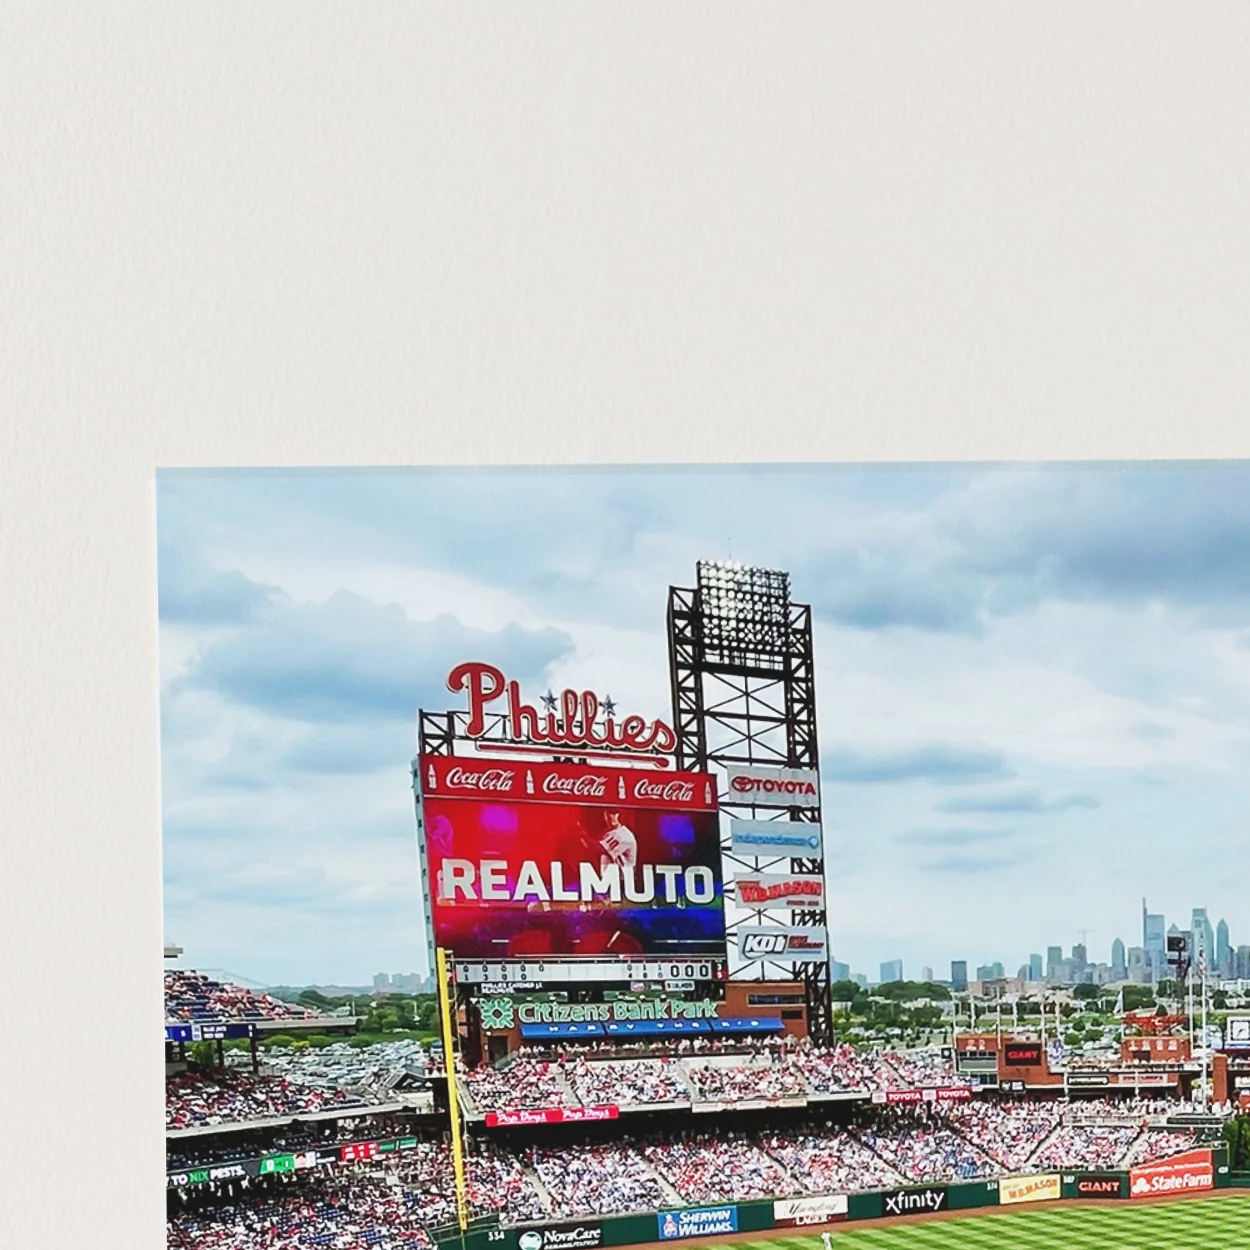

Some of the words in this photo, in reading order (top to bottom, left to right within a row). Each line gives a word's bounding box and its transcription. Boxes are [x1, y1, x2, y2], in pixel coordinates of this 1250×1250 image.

[446, 661, 679, 752] Phillies
[751, 779, 816, 795] TOYOTA
[441, 858, 715, 904] REALMUTO
[519, 1003, 611, 1022] Citizens
[613, 1001, 669, 1021] Bank
[668, 999, 719, 1018] Park
[888, 1092, 921, 1100] TOYOTA
[939, 1090, 971, 1098] TOYOTA
[1078, 1180, 1120, 1192] GIANT
[885, 1190, 945, 1213] xfinity
[680, 1210, 731, 1225] SHERWIN
[543, 1227, 601, 1244] NovaCare
